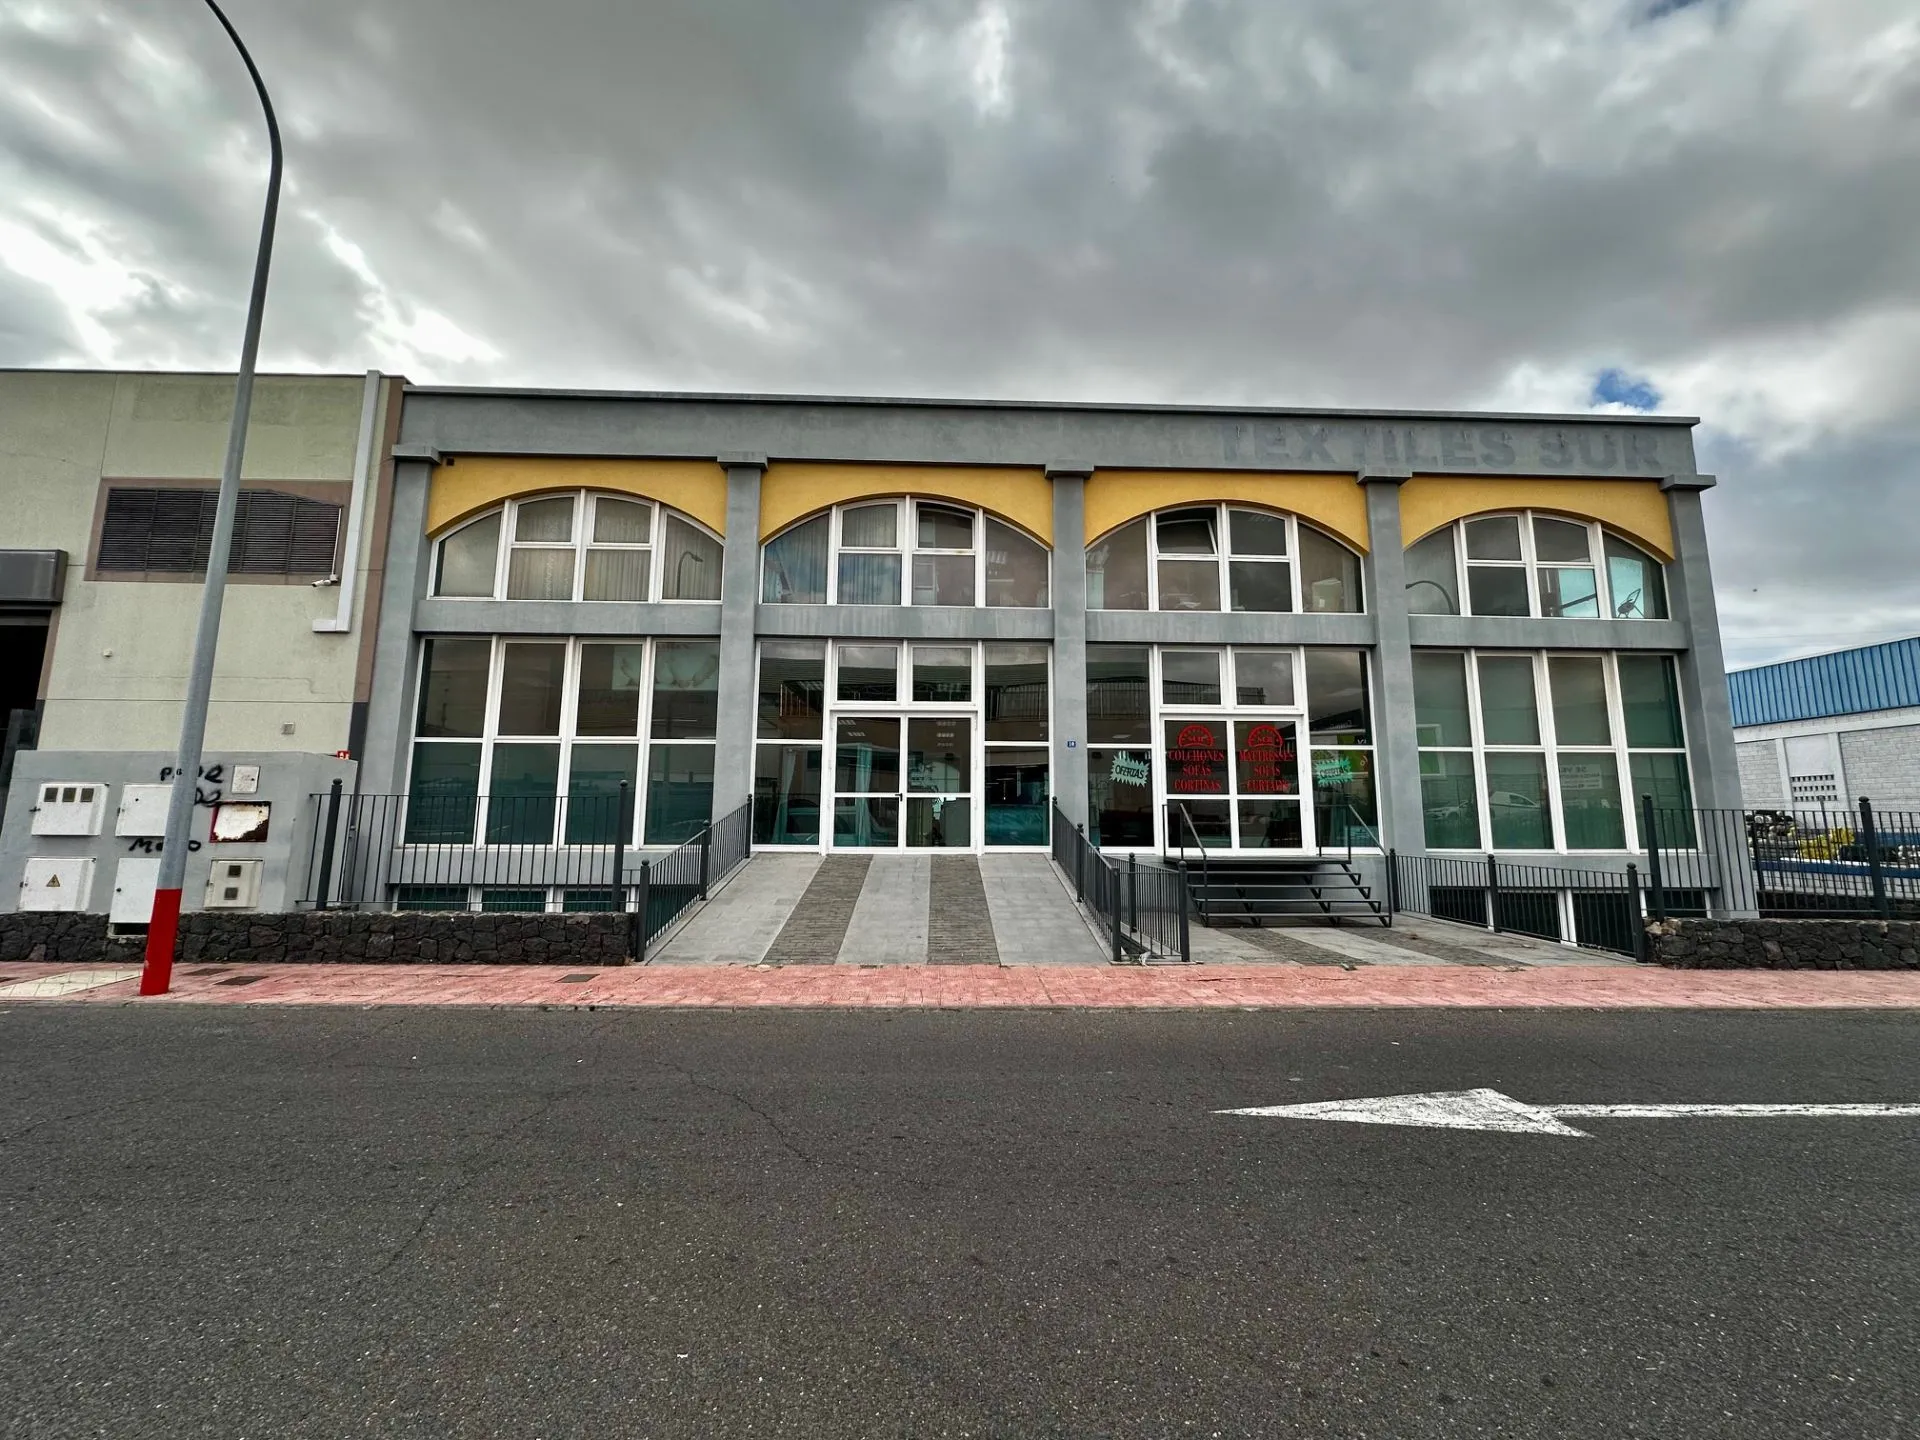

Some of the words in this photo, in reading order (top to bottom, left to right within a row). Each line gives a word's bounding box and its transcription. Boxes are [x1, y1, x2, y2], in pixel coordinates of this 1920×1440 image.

[1219, 422, 1515, 468] TEXTILES
[1541, 429, 1660, 472] SUR
[1168, 749, 1225, 762] COLCHONES
[1115, 764, 1145, 779] OFERTAS
[1173, 779, 1222, 792] CORTINAS
